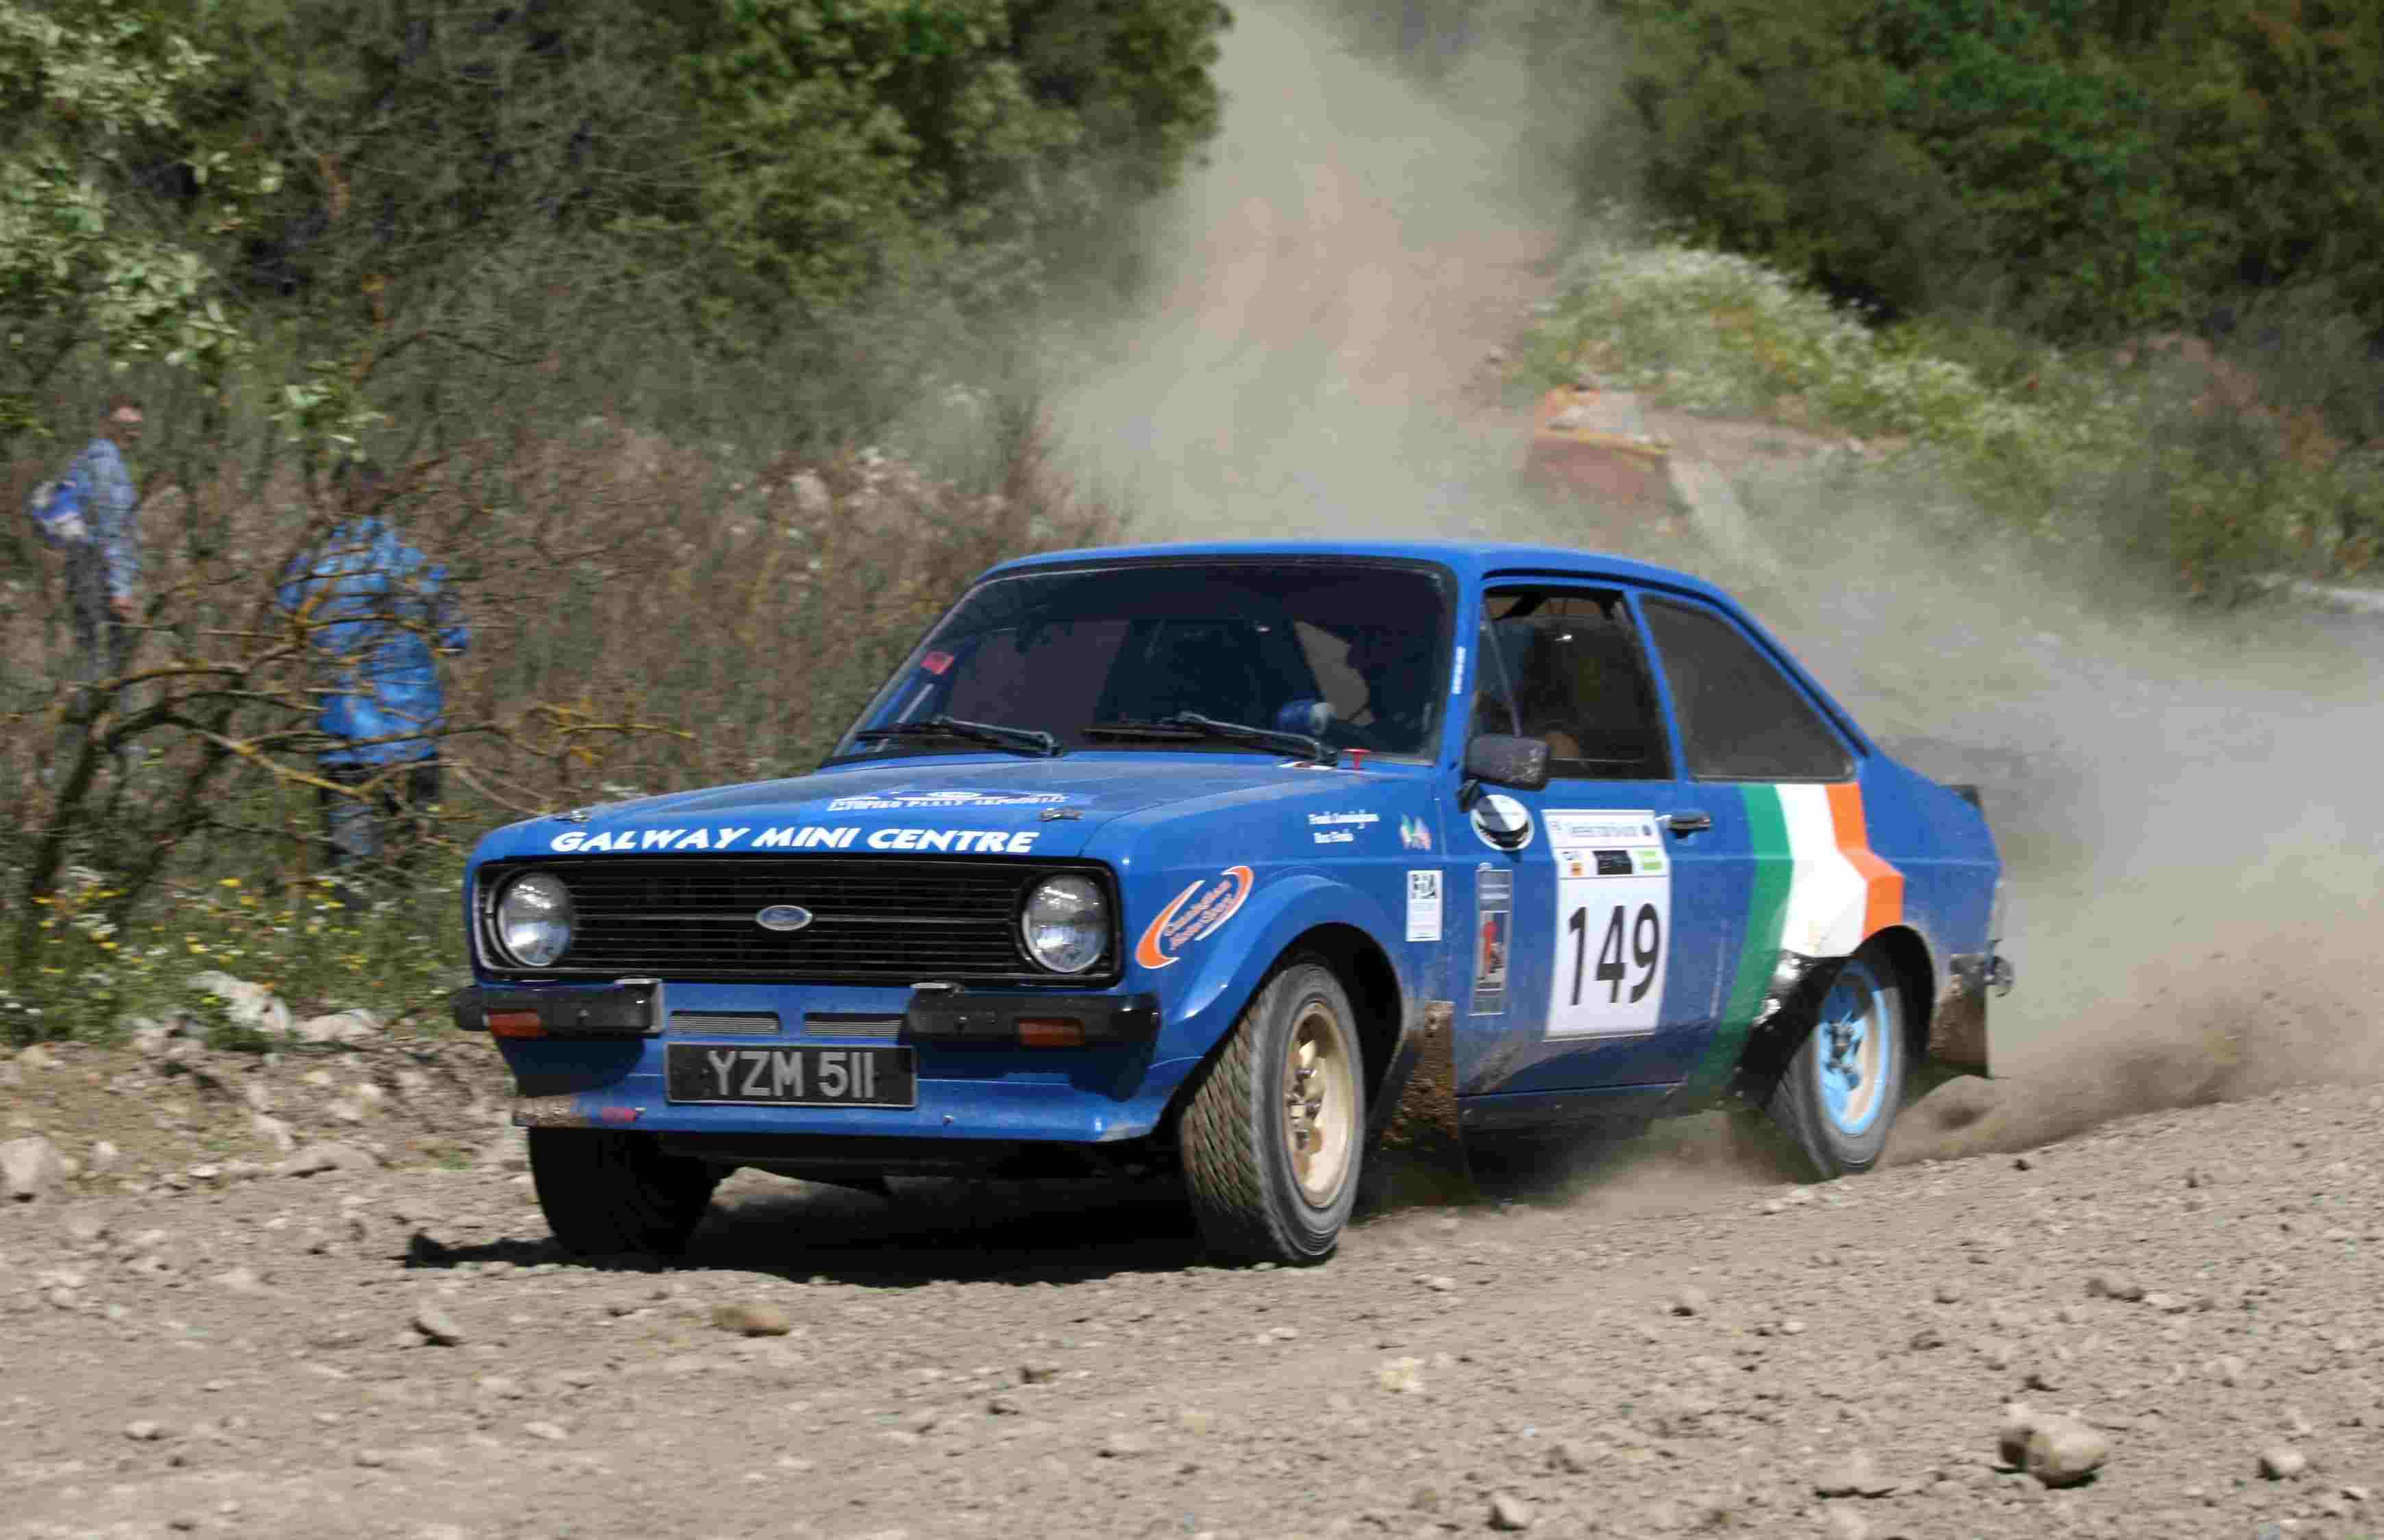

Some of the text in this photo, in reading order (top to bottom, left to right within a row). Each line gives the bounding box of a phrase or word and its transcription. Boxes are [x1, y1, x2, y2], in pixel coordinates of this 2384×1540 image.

[550, 827, 1041, 854] GALWAY MINI CENTRE
[1568, 903, 1660, 1006] 149
[707, 1050, 874, 1098] YZM 511
